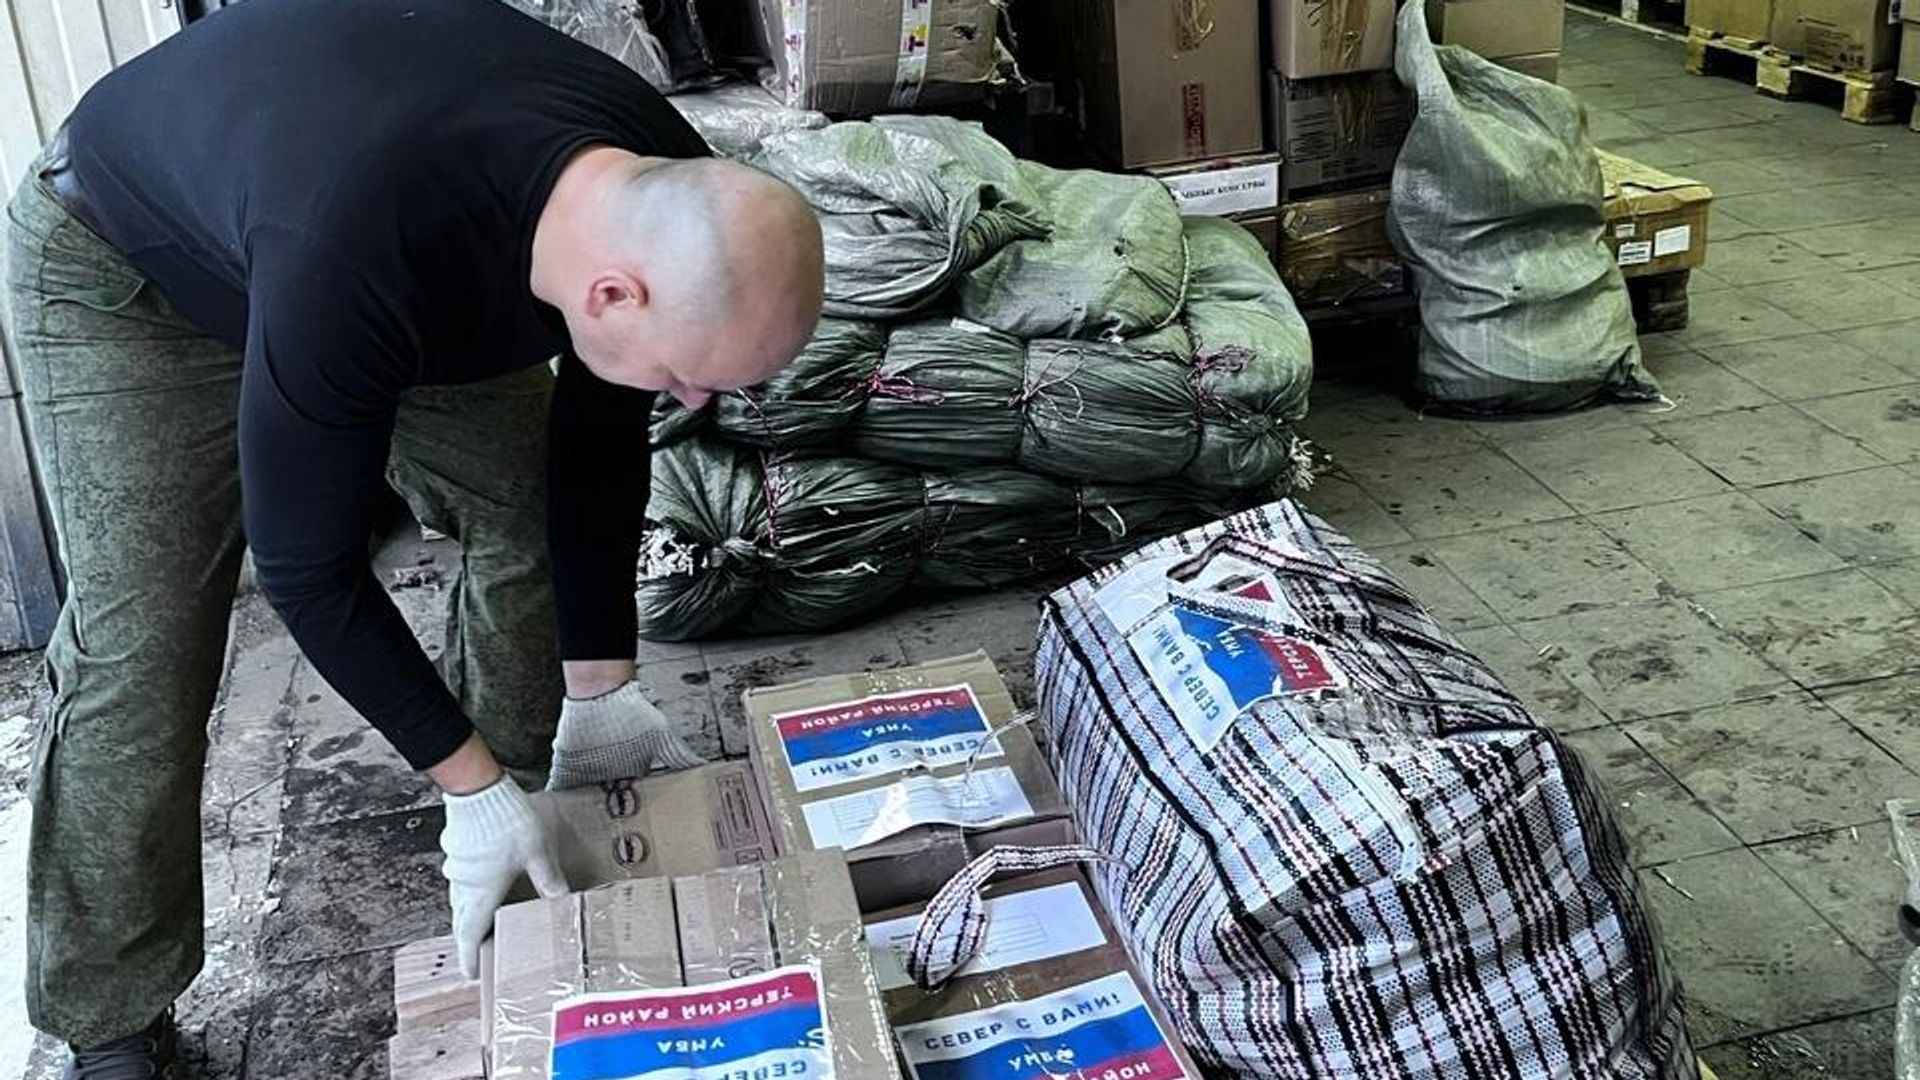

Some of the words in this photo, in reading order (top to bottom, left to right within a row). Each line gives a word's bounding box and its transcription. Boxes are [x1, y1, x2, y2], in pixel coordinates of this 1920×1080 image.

[871, 697, 957, 717] ТЕРСКИЙ
[799, 709, 866, 730] РАЙОН
[861, 722, 914, 739] УМБА
[890, 749, 903, 759] С
[810, 753, 881, 777] ВАМИ!
[681, 985, 795, 1022] ТЕРСКИЙ
[583, 1006, 670, 1029] РАЙОН
[924, 1022, 1004, 1051] СЕВЕР
[1017, 1015, 1031, 1030] С
[1041, 992, 1122, 1026] ВАМИ!
[657, 1036, 726, 1054] УМБА
